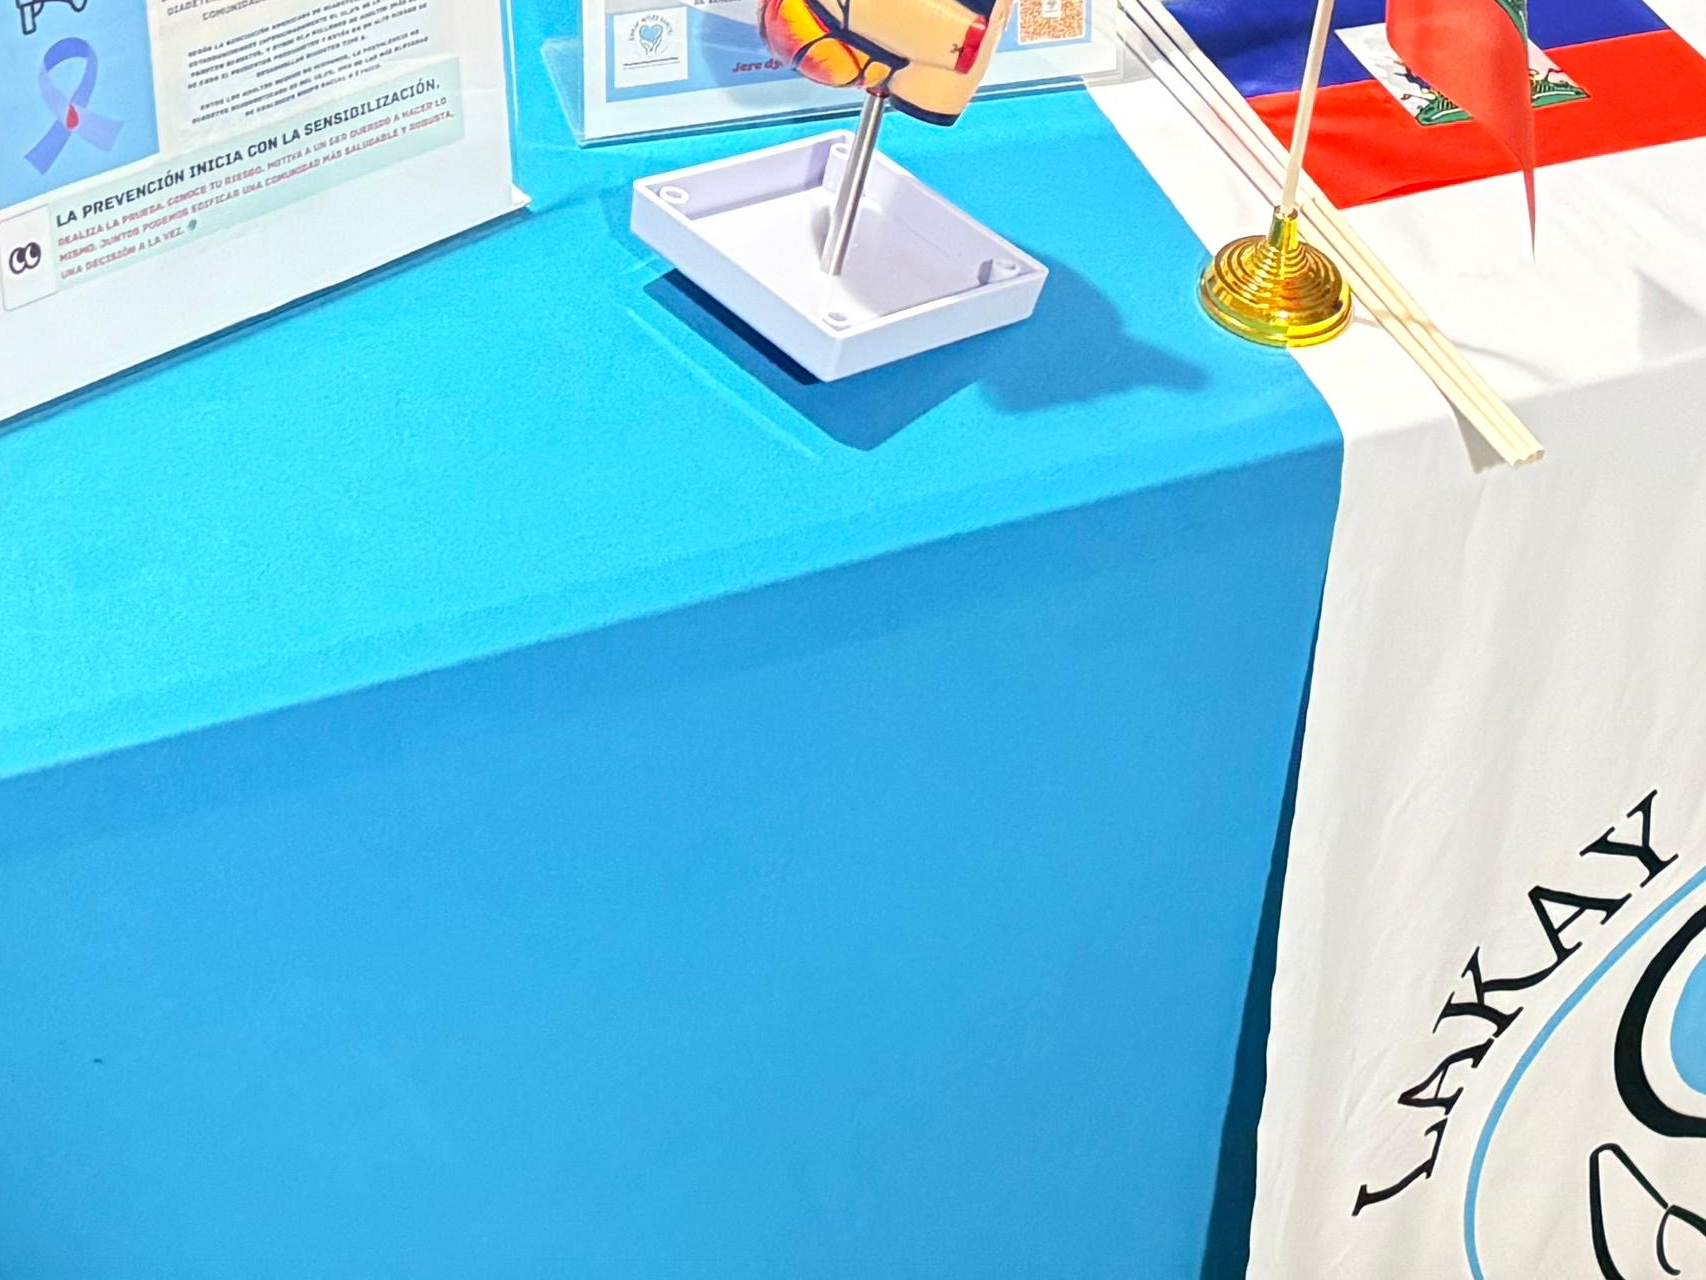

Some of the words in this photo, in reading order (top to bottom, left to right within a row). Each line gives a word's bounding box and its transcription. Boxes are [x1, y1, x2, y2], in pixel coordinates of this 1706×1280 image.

[56, 209, 77, 227] LA
[82, 169, 184, 217] PREVENCIÓN
[189, 150, 243, 178] INICIA
[247, 136, 277, 157] CON
[281, 128, 300, 145] LA
[1351, 790, 1680, 1219] LAKAY
